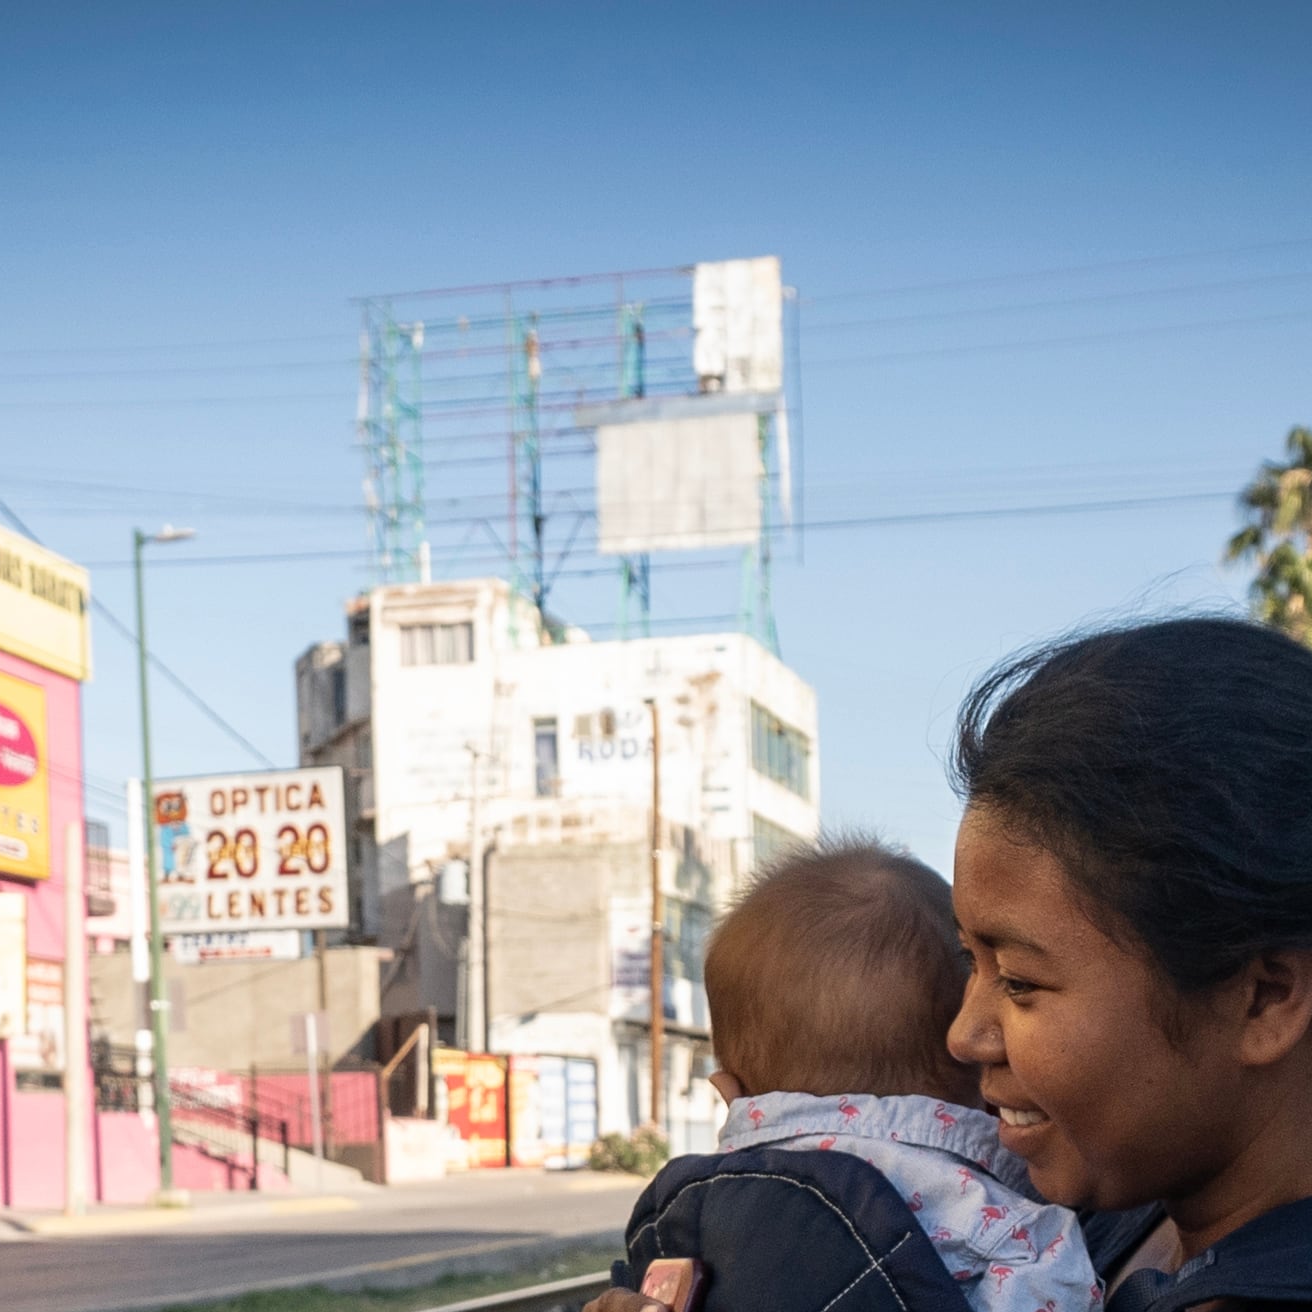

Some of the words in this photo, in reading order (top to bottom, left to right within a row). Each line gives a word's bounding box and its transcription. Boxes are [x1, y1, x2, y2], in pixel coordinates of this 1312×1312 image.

[209, 782, 326, 818] OPTICA
[206, 828, 259, 880] 20
[276, 822, 330, 876] 20
[206, 885, 334, 920] LENTES
